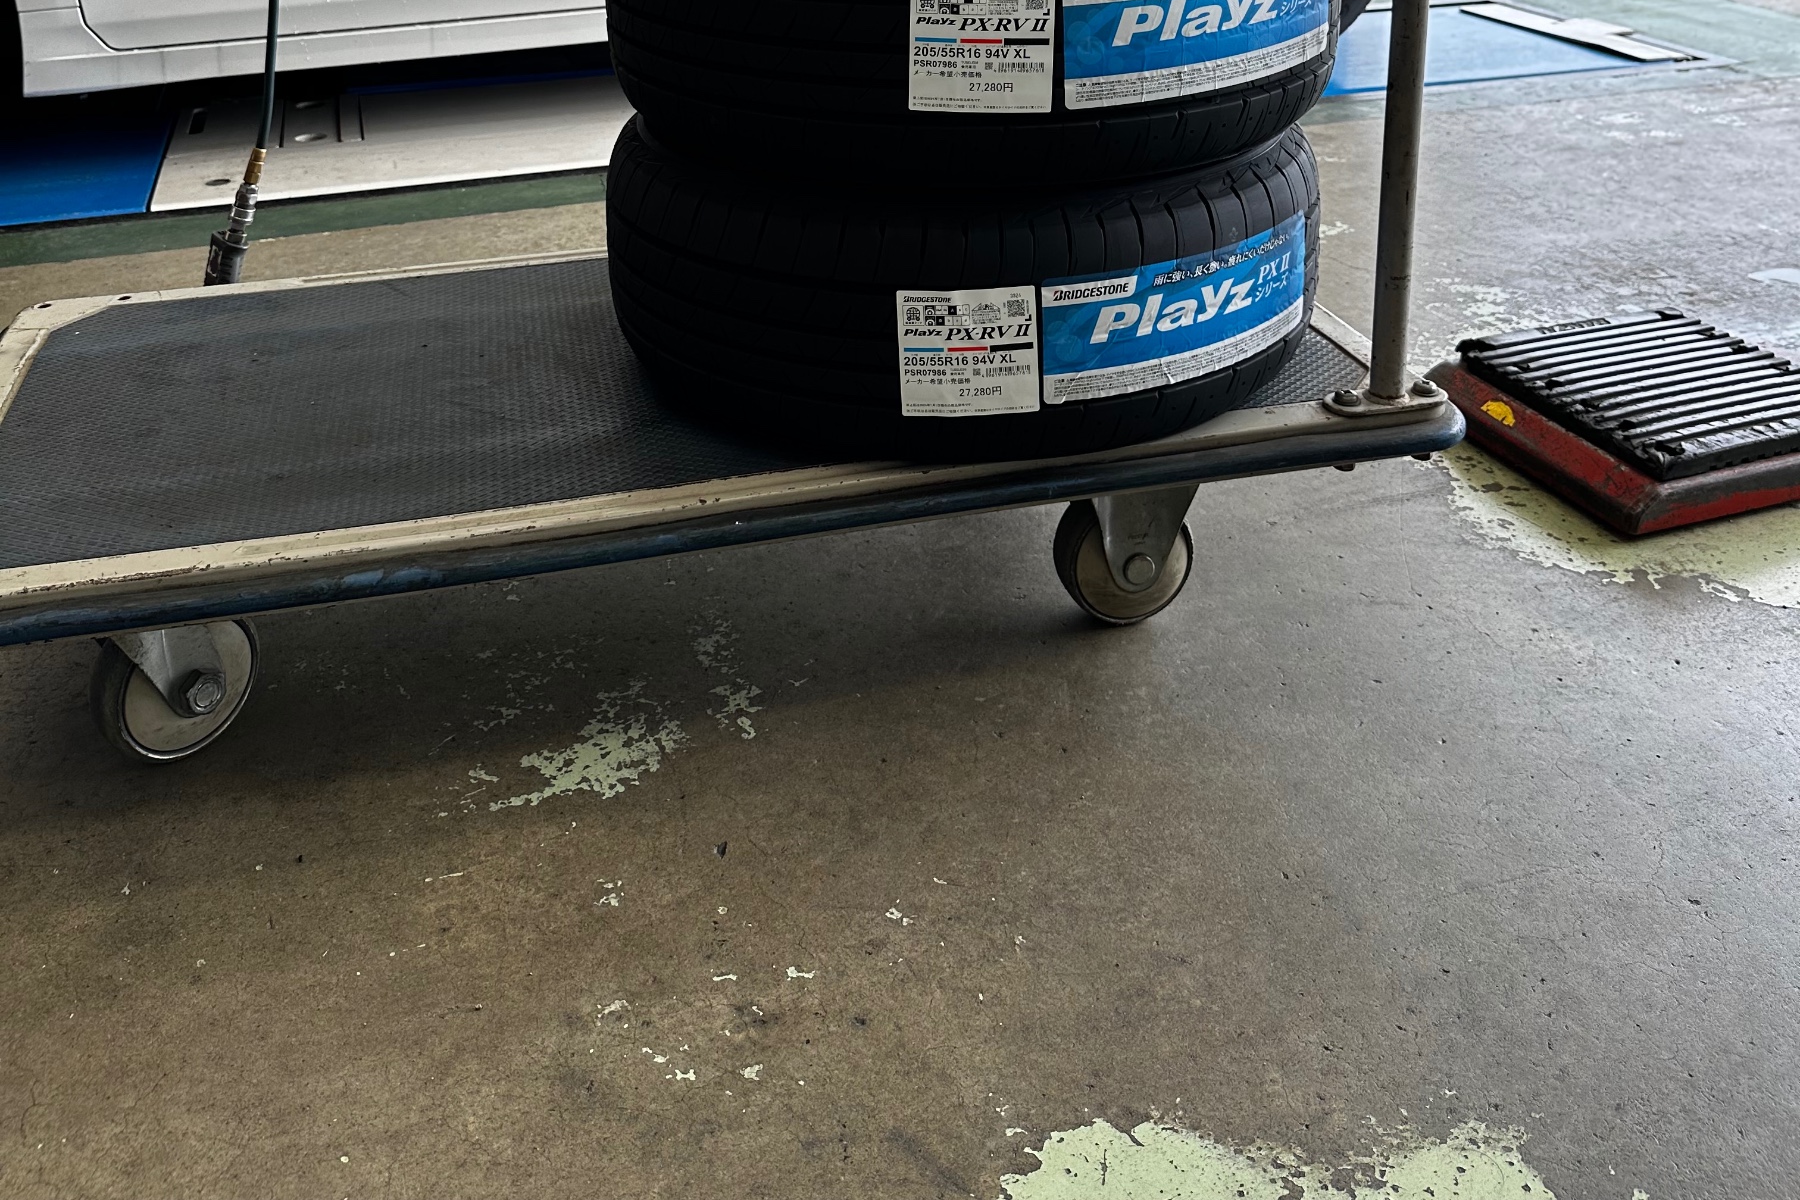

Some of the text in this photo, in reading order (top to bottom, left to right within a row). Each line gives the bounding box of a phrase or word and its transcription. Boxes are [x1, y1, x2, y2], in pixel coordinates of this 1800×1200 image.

[915, 16, 957, 25] Playz
[958, 18, 1030, 31] PX-RV
[913, 46, 981, 58] 205/55R16
[985, 48, 1010, 59] 94V
[1013, 49, 1031, 59] XL
[913, 59, 958, 69] PSR07986
[969, 82, 1014, 92] 27,280円
[1256, 261, 1279, 285] PX
[1052, 282, 1129, 302] BRIDGESTONE
[1254, 274, 1289, 303] シリーズ
[903, 295, 951, 303] BRIDGESTONE
[1089, 277, 1257, 345] Playz
[903, 328, 943, 337] Playz
[945, 325, 1013, 341] PX-RV
[904, 356, 969, 367] 205/55R16
[972, 355, 996, 365] 94V
[999, 353, 1017, 364] XL
[959, 386, 1002, 397] 27,280円
